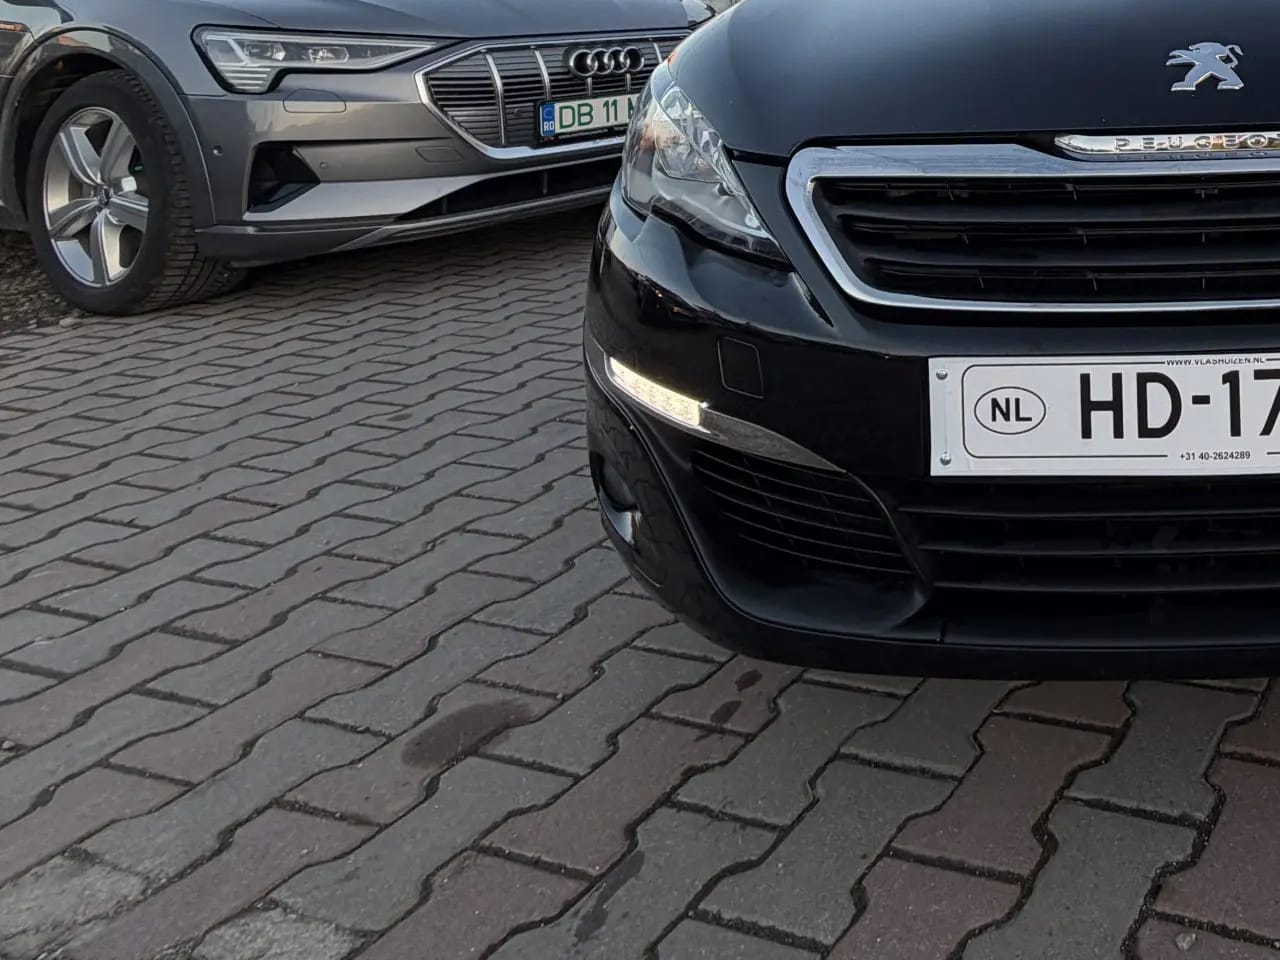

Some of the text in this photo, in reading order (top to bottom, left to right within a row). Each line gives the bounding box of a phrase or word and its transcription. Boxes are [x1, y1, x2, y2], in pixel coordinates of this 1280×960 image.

[559, 103, 594, 129] DB
[603, 99, 618, 122] 11
[543, 121, 555, 131] RO
[990, 397, 1033, 423] NL
[1180, 451, 1251, 461] +31 40-2624289
